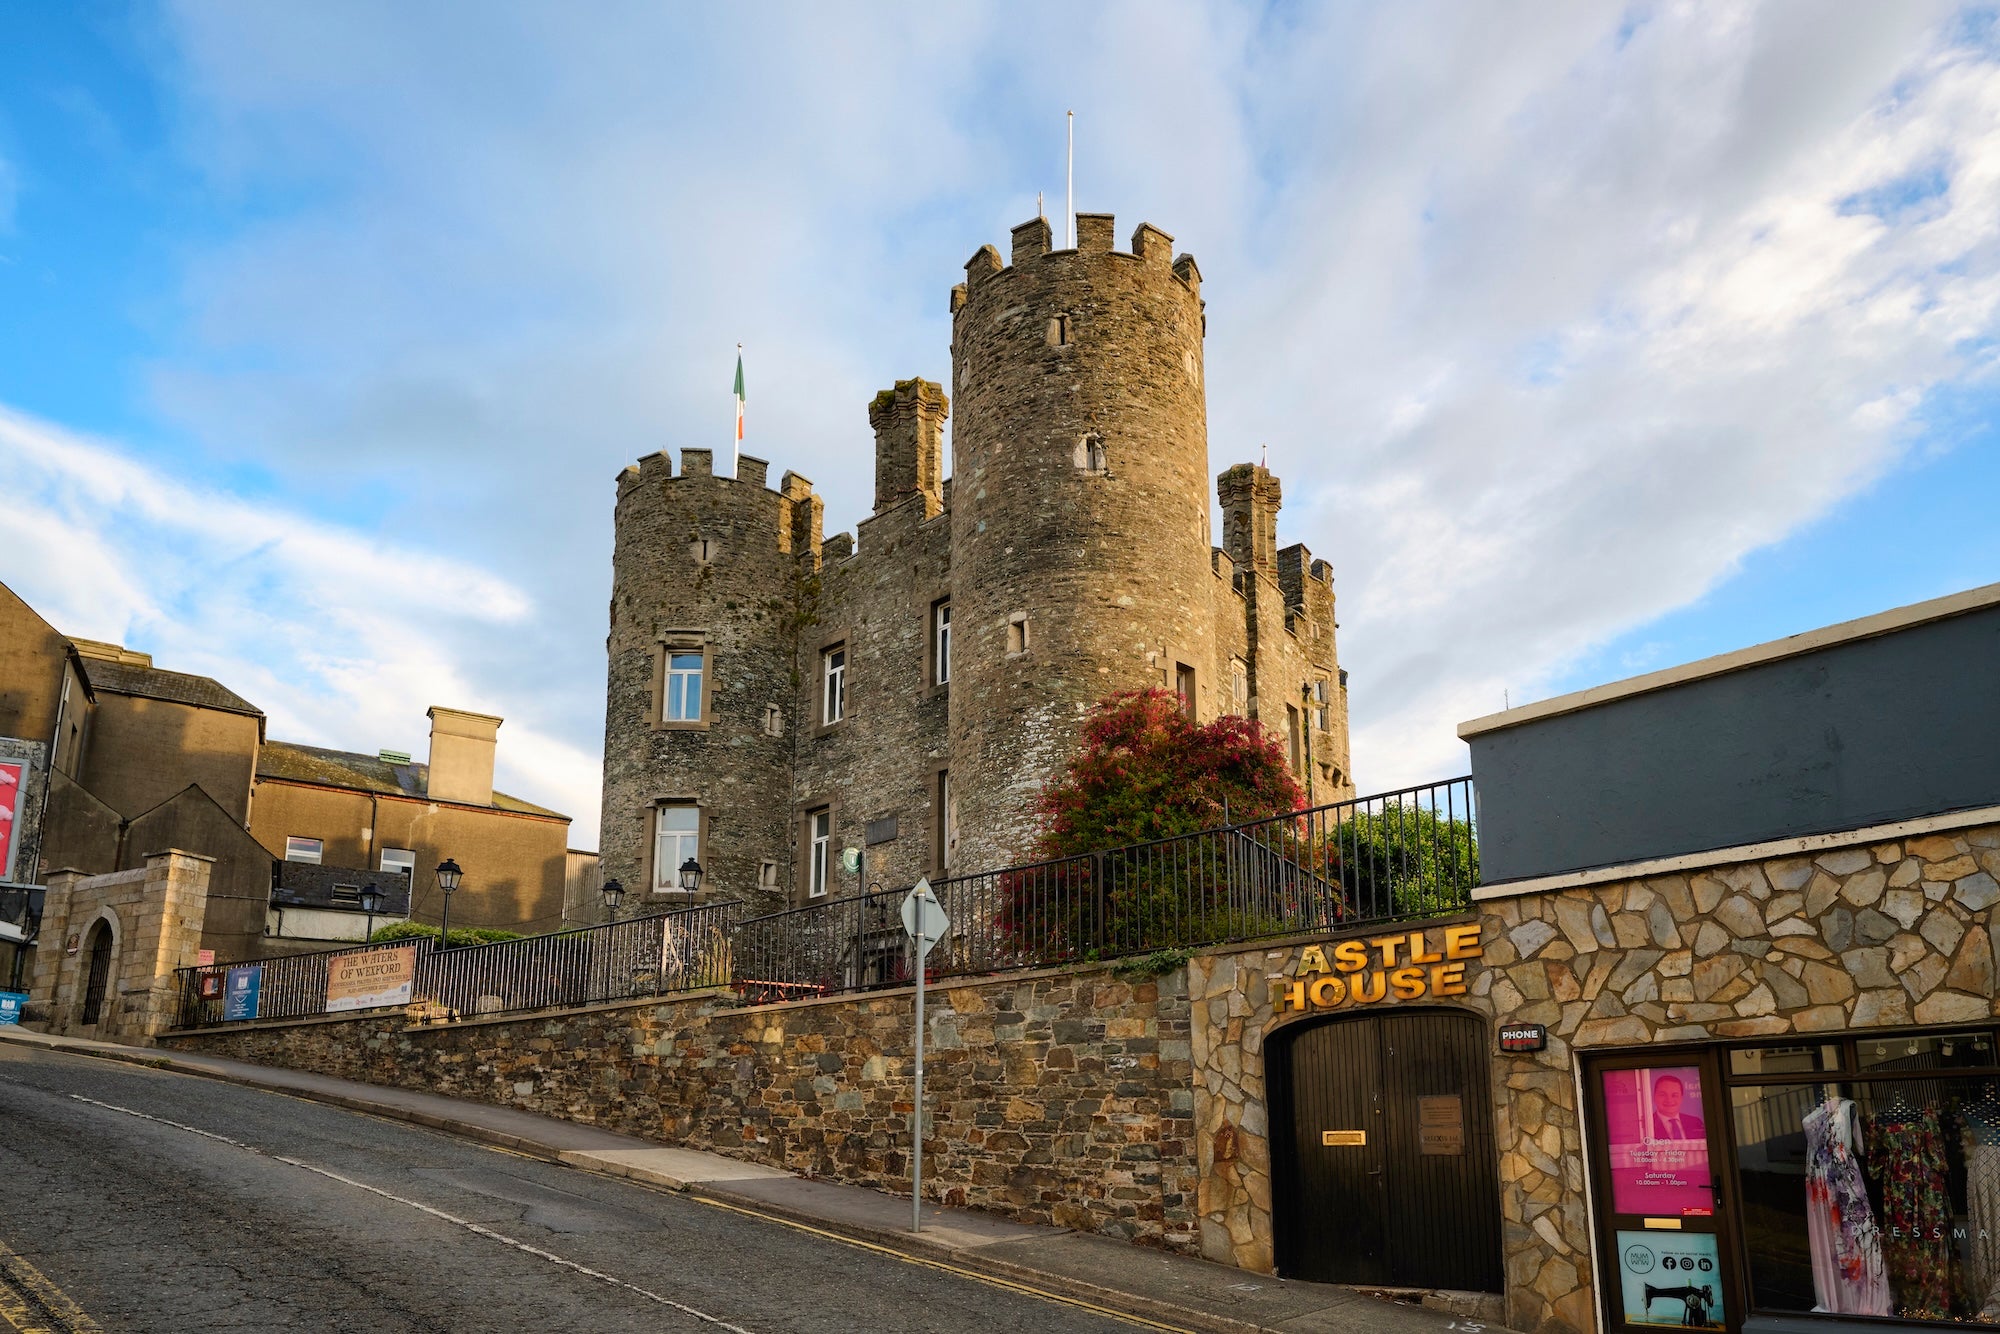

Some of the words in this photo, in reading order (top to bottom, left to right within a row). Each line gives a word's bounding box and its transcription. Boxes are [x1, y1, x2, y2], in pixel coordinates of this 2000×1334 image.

[343, 956, 358, 967] THE
[361, 951, 398, 965] WATERS
[1295, 925, 1483, 977] ASTLE
[340, 969, 353, 980] OF
[356, 963, 401, 977] WEXFORD
[1273, 962, 1467, 1013] HOUSE
[1502, 1030, 1538, 1040] PHONE
[1643, 1136, 1672, 1146] Open
[1664, 1149, 1686, 1157] Friday
